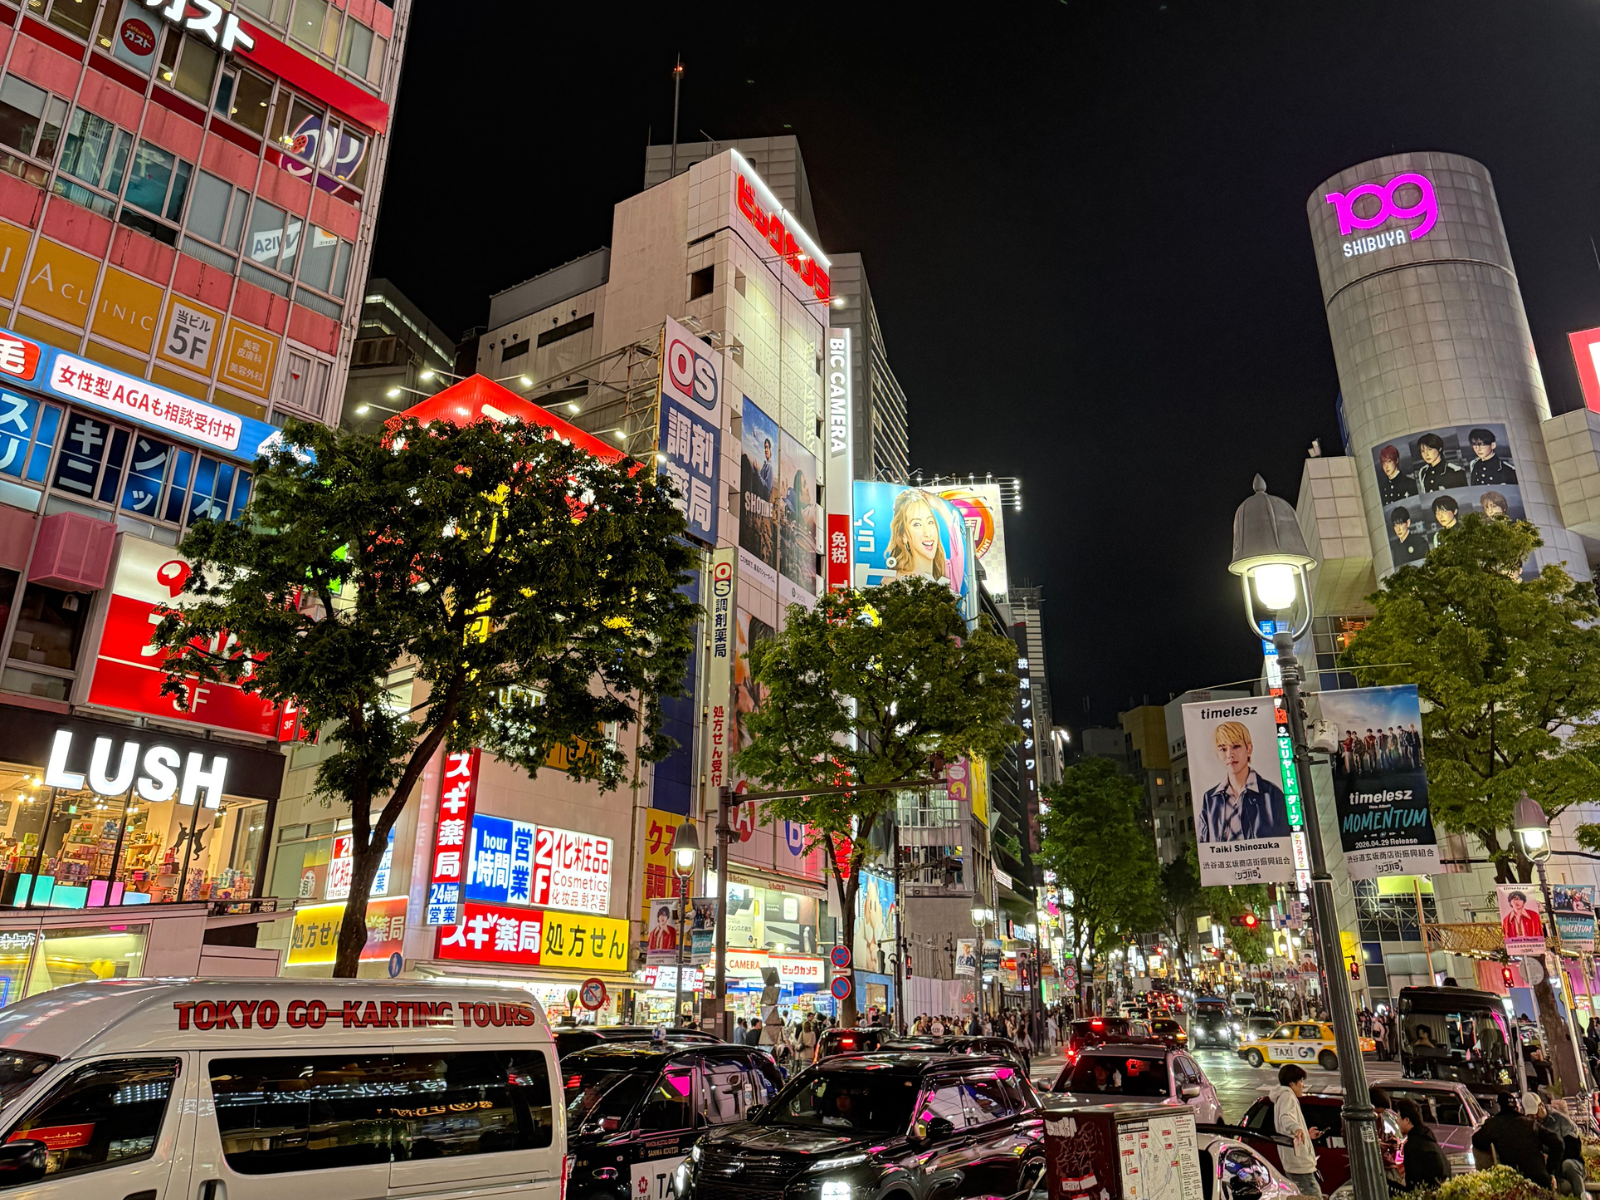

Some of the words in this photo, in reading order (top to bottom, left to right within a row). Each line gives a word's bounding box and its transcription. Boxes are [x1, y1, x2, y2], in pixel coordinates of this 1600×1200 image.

[124, 29, 152, 49] ガスト
[1325, 172, 1438, 240] 109
[737, 172, 830, 307] ビックカメラ
[1342, 229, 1407, 258] SHIBUYA
[176, 309, 211, 333] 当ビル
[168, 325, 207, 361] 5F
[237, 347, 263, 364] 皮膚科
[243, 338, 261, 353] 美容
[829, 338, 847, 368] BIC
[229, 362, 263, 384] 美容外科
[670, 341, 716, 403] OS
[829, 372, 847, 452] CAMERA
[666, 407, 714, 479] 調剤
[831, 531, 847, 565] 免税
[715, 565, 731, 597] OS
[714, 598, 728, 659] 調剤薬局
[1200, 705, 1258, 720] timelesz
[711, 705, 725, 788] 処方せん受付
[45, 729, 229, 810] LUSH
[1279, 739, 1301, 824] ビリヤード・ダーツ
[1349, 789, 1413, 805] timelesz
[434, 752, 471, 878] スギ薬局
[1342, 806, 1428, 834] MOMENTUM
[483, 830, 508, 850] hour
[554, 833, 610, 875] 化粧品
[1209, 845, 1233, 854] Taiki
[1234, 842, 1280, 853] Shinozuka
[1354, 838, 1390, 849] 2026.04.29
[1390, 837, 1418, 846] Release
[476, 850, 510, 890] 時間
[510, 826, 533, 900] 営業
[534, 830, 554, 903] 2F
[431, 883, 445, 905] 24
[553, 870, 609, 893] Cosmetics
[429, 906, 457, 925] 営業
[545, 921, 625, 960] 処方せん
[729, 959, 760, 970] CAMERA
[782, 965, 818, 976] ビックカメラ
[174, 1000, 280, 1031] TOKYO
[286, 1000, 453, 1029] GO-KARTING
[458, 1001, 535, 1028] TOURS
[1274, 1047, 1294, 1057] TAXI
